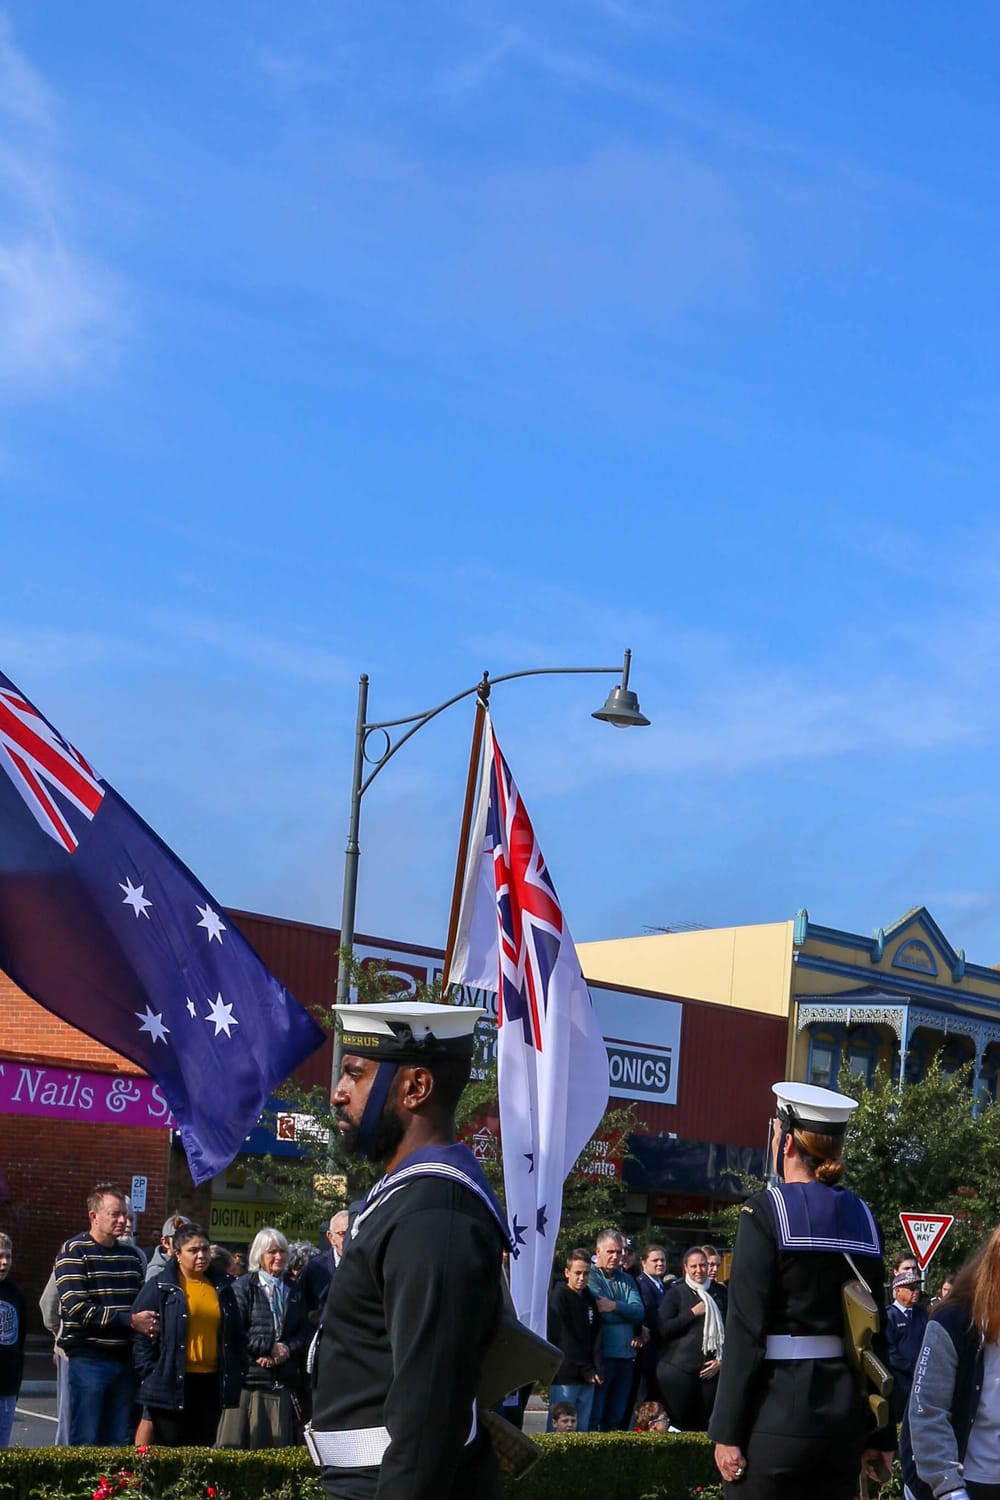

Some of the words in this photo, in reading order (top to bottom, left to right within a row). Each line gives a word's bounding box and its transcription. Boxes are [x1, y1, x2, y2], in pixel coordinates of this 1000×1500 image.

[11, 1067, 95, 1110] Nails
[106, 1078, 141, 1113] &
[211, 1207, 251, 1228] DIGITAL
[913, 1222, 935, 1233] GIVE
[916, 1233, 930, 1241] WAY
